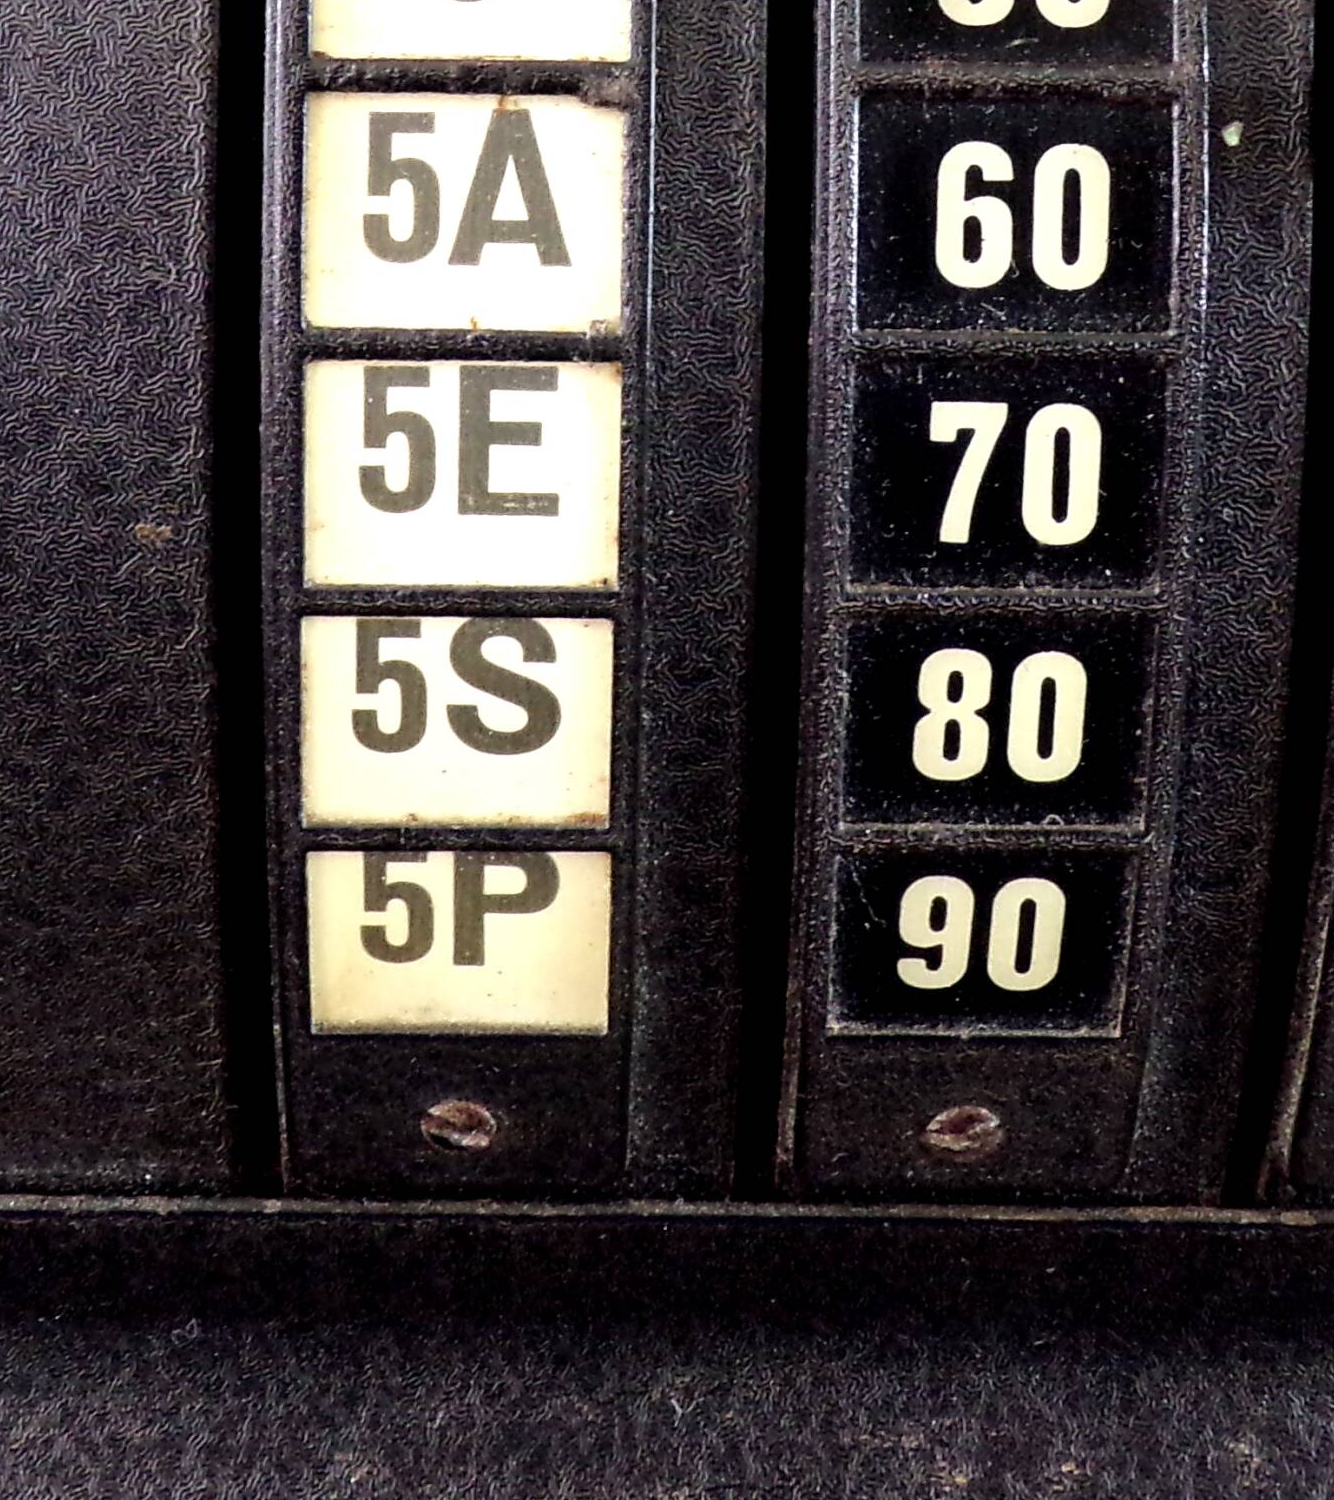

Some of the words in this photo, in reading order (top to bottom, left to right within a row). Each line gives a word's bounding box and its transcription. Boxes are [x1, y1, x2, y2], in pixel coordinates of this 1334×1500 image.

[364, 110, 572, 268] 5A
[935, 141, 1111, 291] 60
[358, 366, 560, 517] 5E
[929, 401, 1103, 547] 70
[350, 617, 562, 755] 5S
[912, 647, 1087, 783] 80
[359, 851, 561, 967] 5P
[897, 874, 1067, 992] 90
